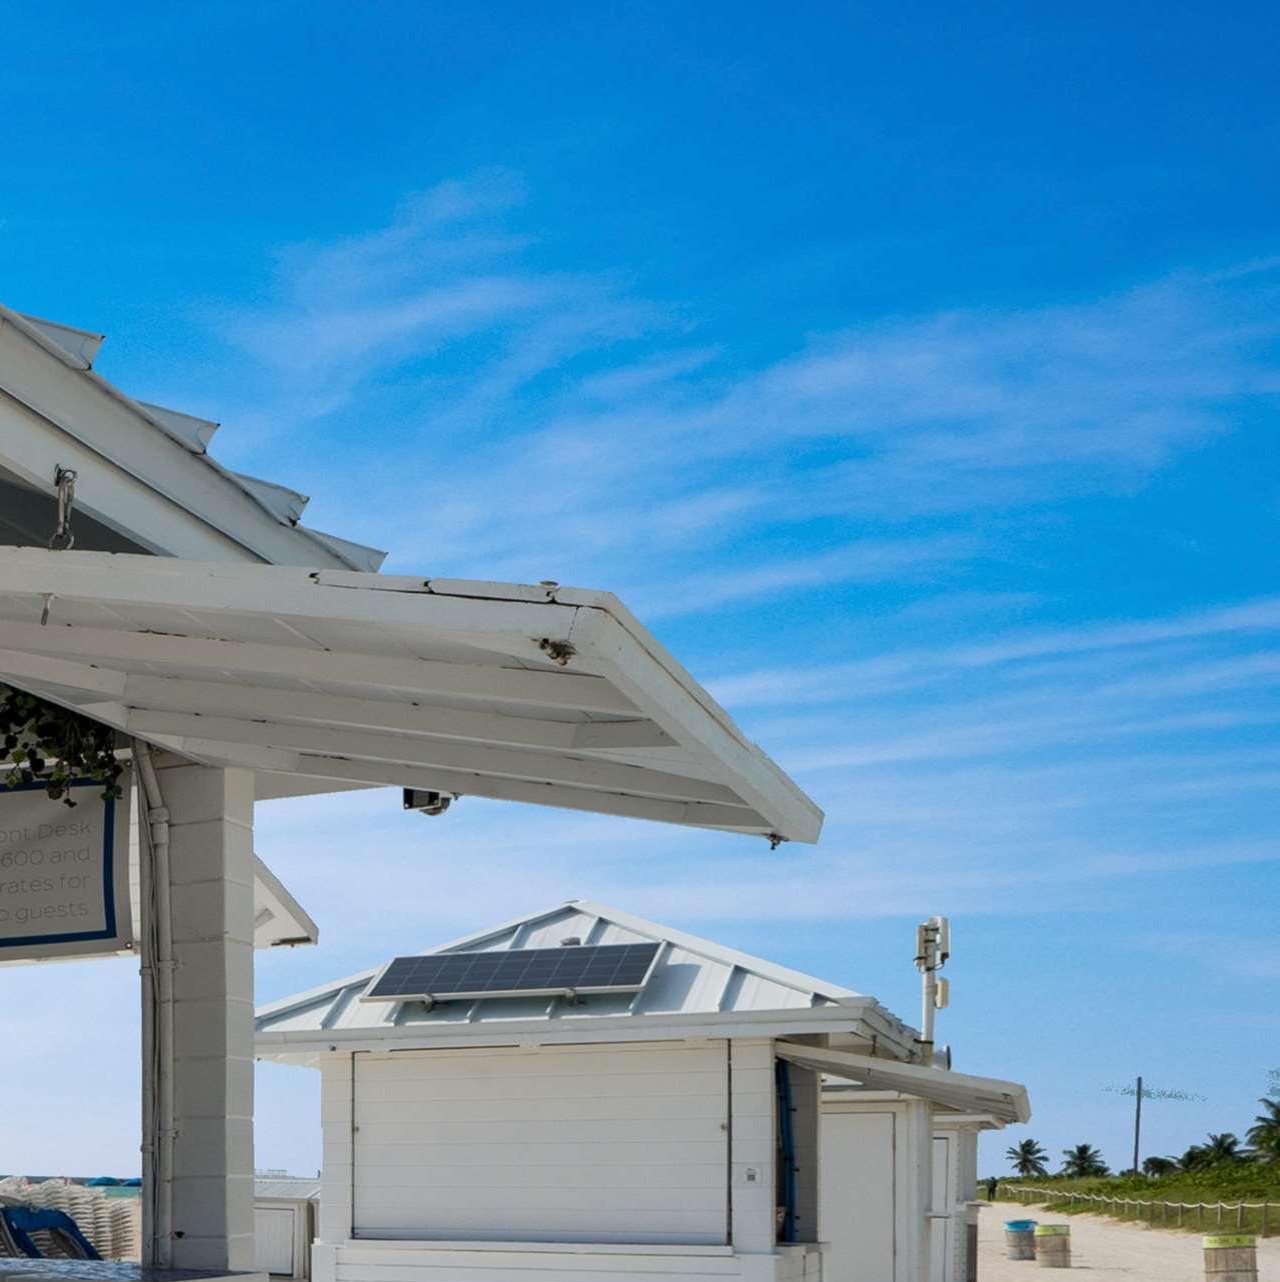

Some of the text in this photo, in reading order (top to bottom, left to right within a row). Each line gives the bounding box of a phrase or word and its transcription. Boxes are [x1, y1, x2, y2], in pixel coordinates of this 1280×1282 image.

[39, 820, 92, 840] Desk
[50, 846, 90, 865] and
[0, 878, 54, 895] rates
[59, 872, 91, 889] for
[15, 900, 89, 924] guests
